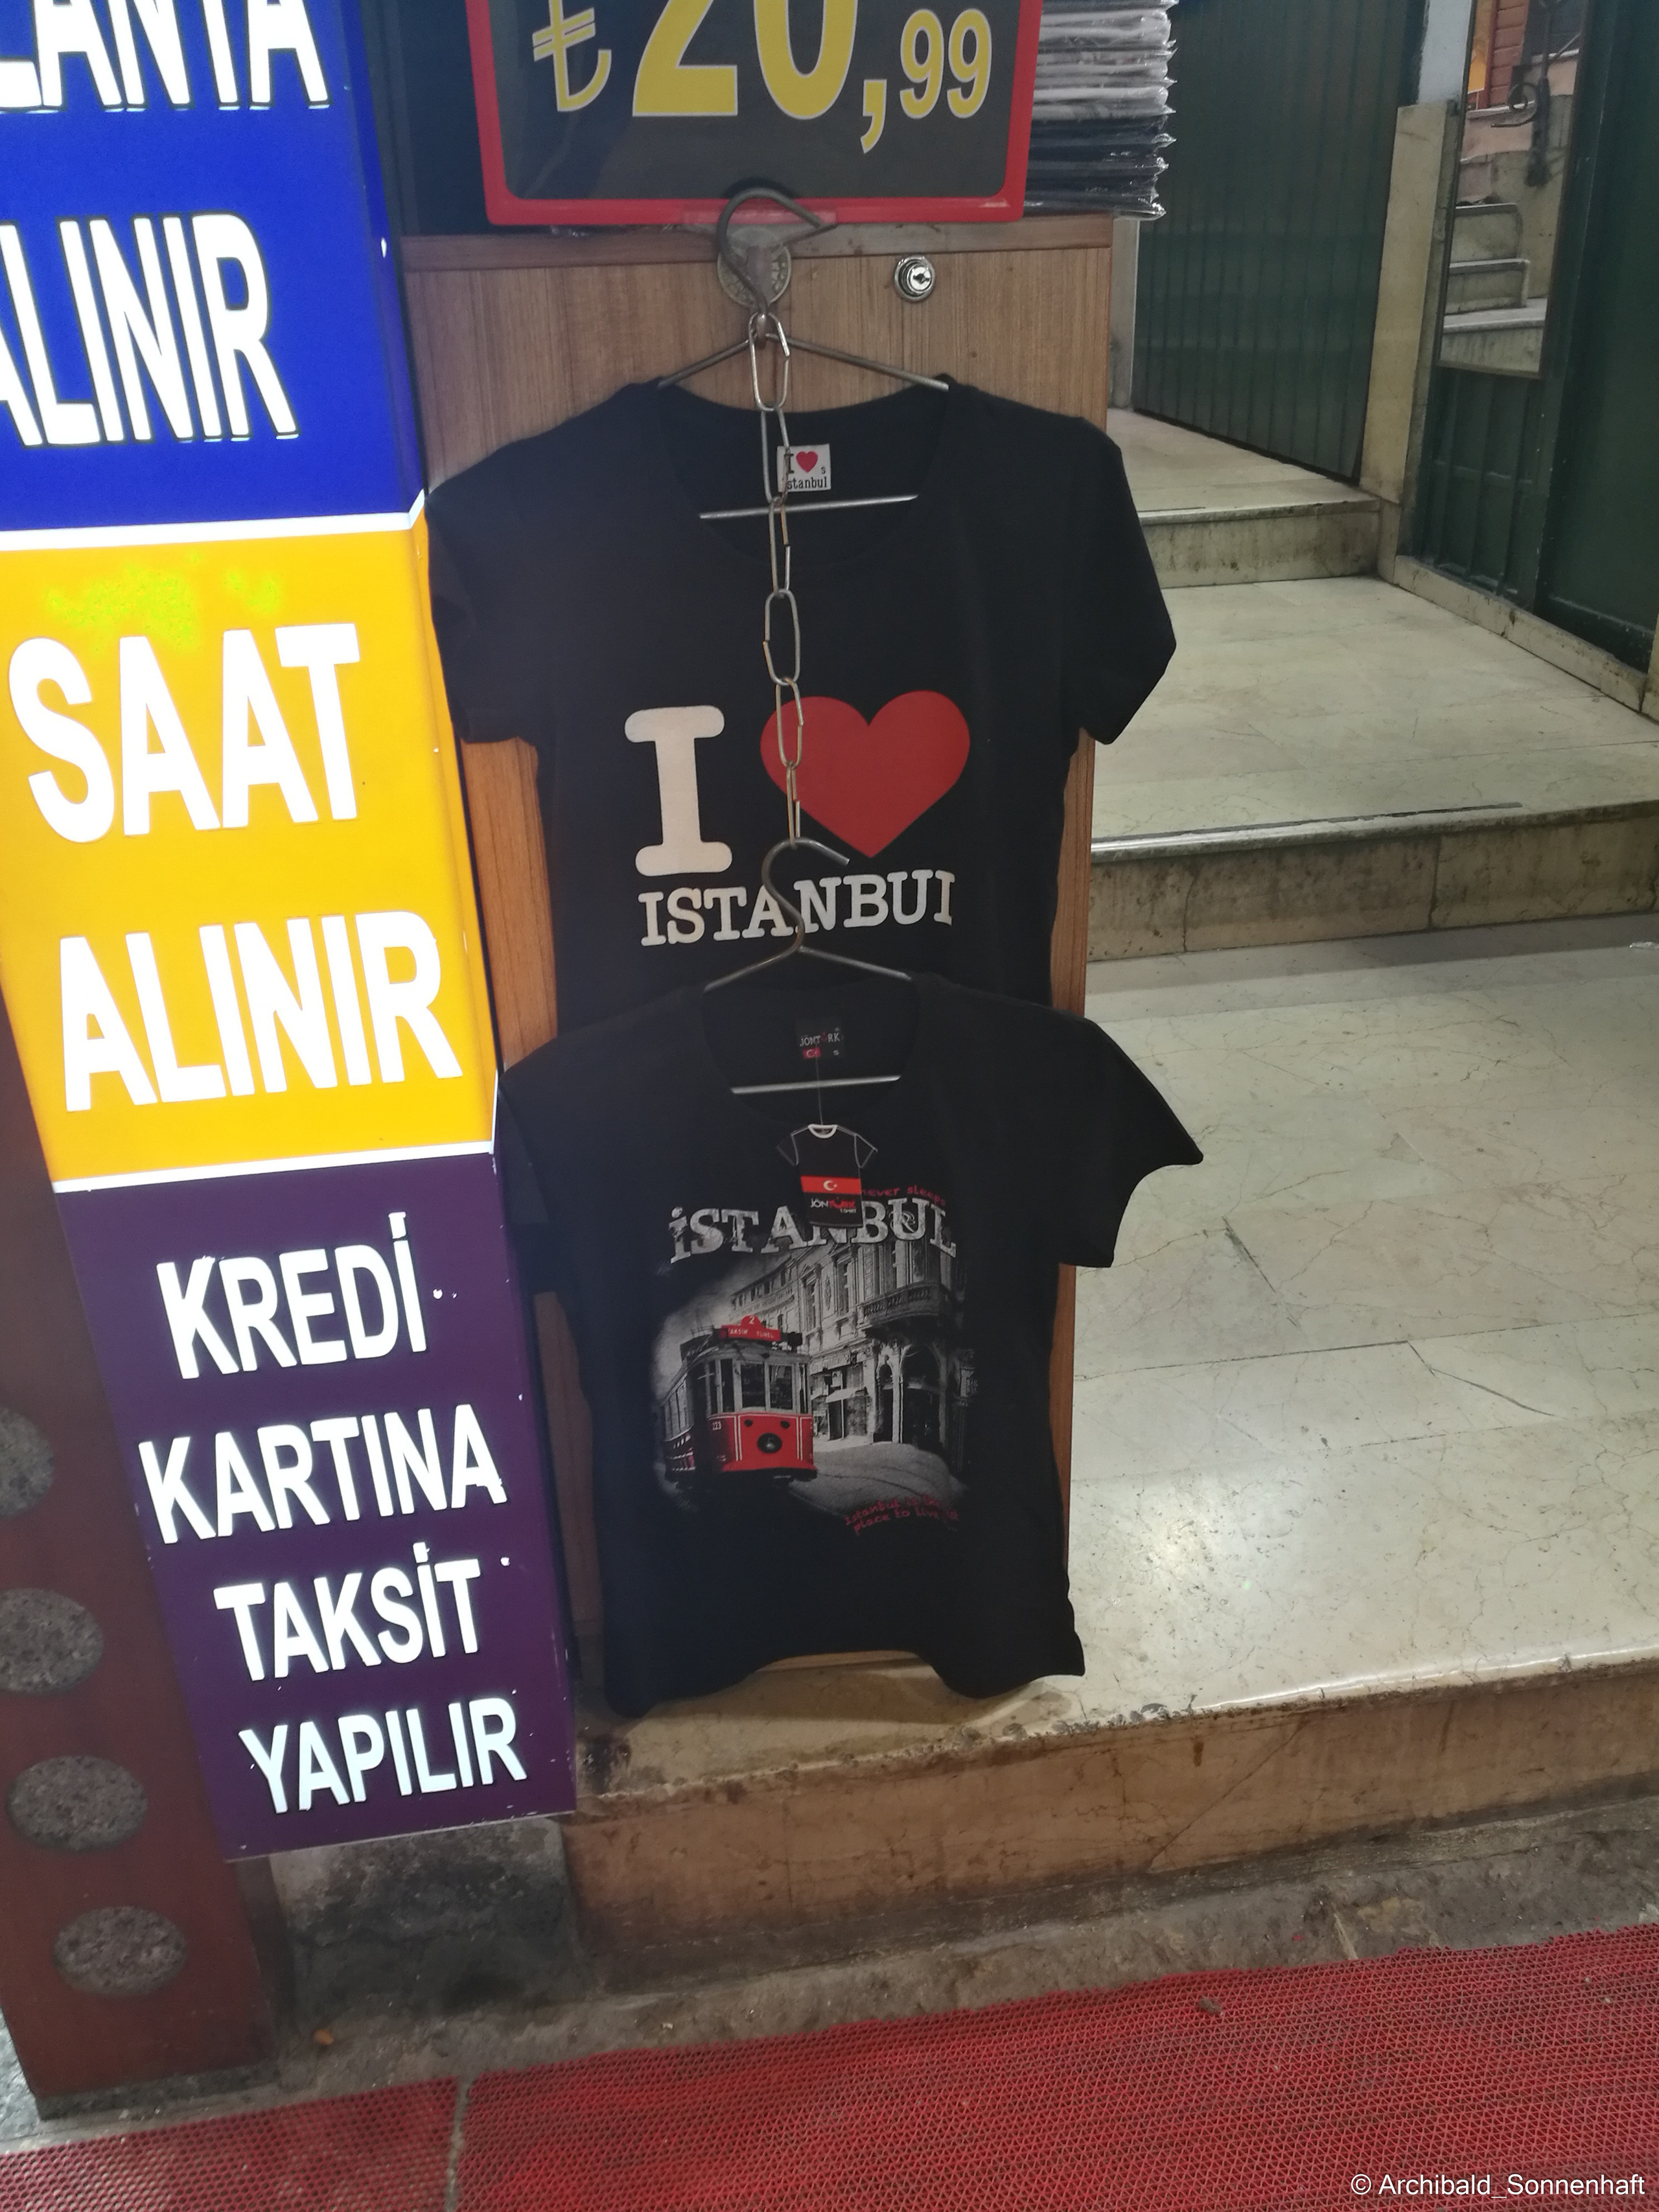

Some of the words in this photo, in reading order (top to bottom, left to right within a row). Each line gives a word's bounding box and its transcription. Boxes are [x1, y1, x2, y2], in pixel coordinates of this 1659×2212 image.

[783, 476, 828, 490] stanbul
[8, 623, 360, 843] SAAT
[624, 704, 732, 877] I
[60, 911, 463, 1112] ALINIR
[156, 1212, 426, 1379] KREDİ
[138, 1404, 507, 1544] KARTINA
[213, 1542, 480, 1681] TAKSİT
[238, 1697, 527, 1813] YAPILIR
